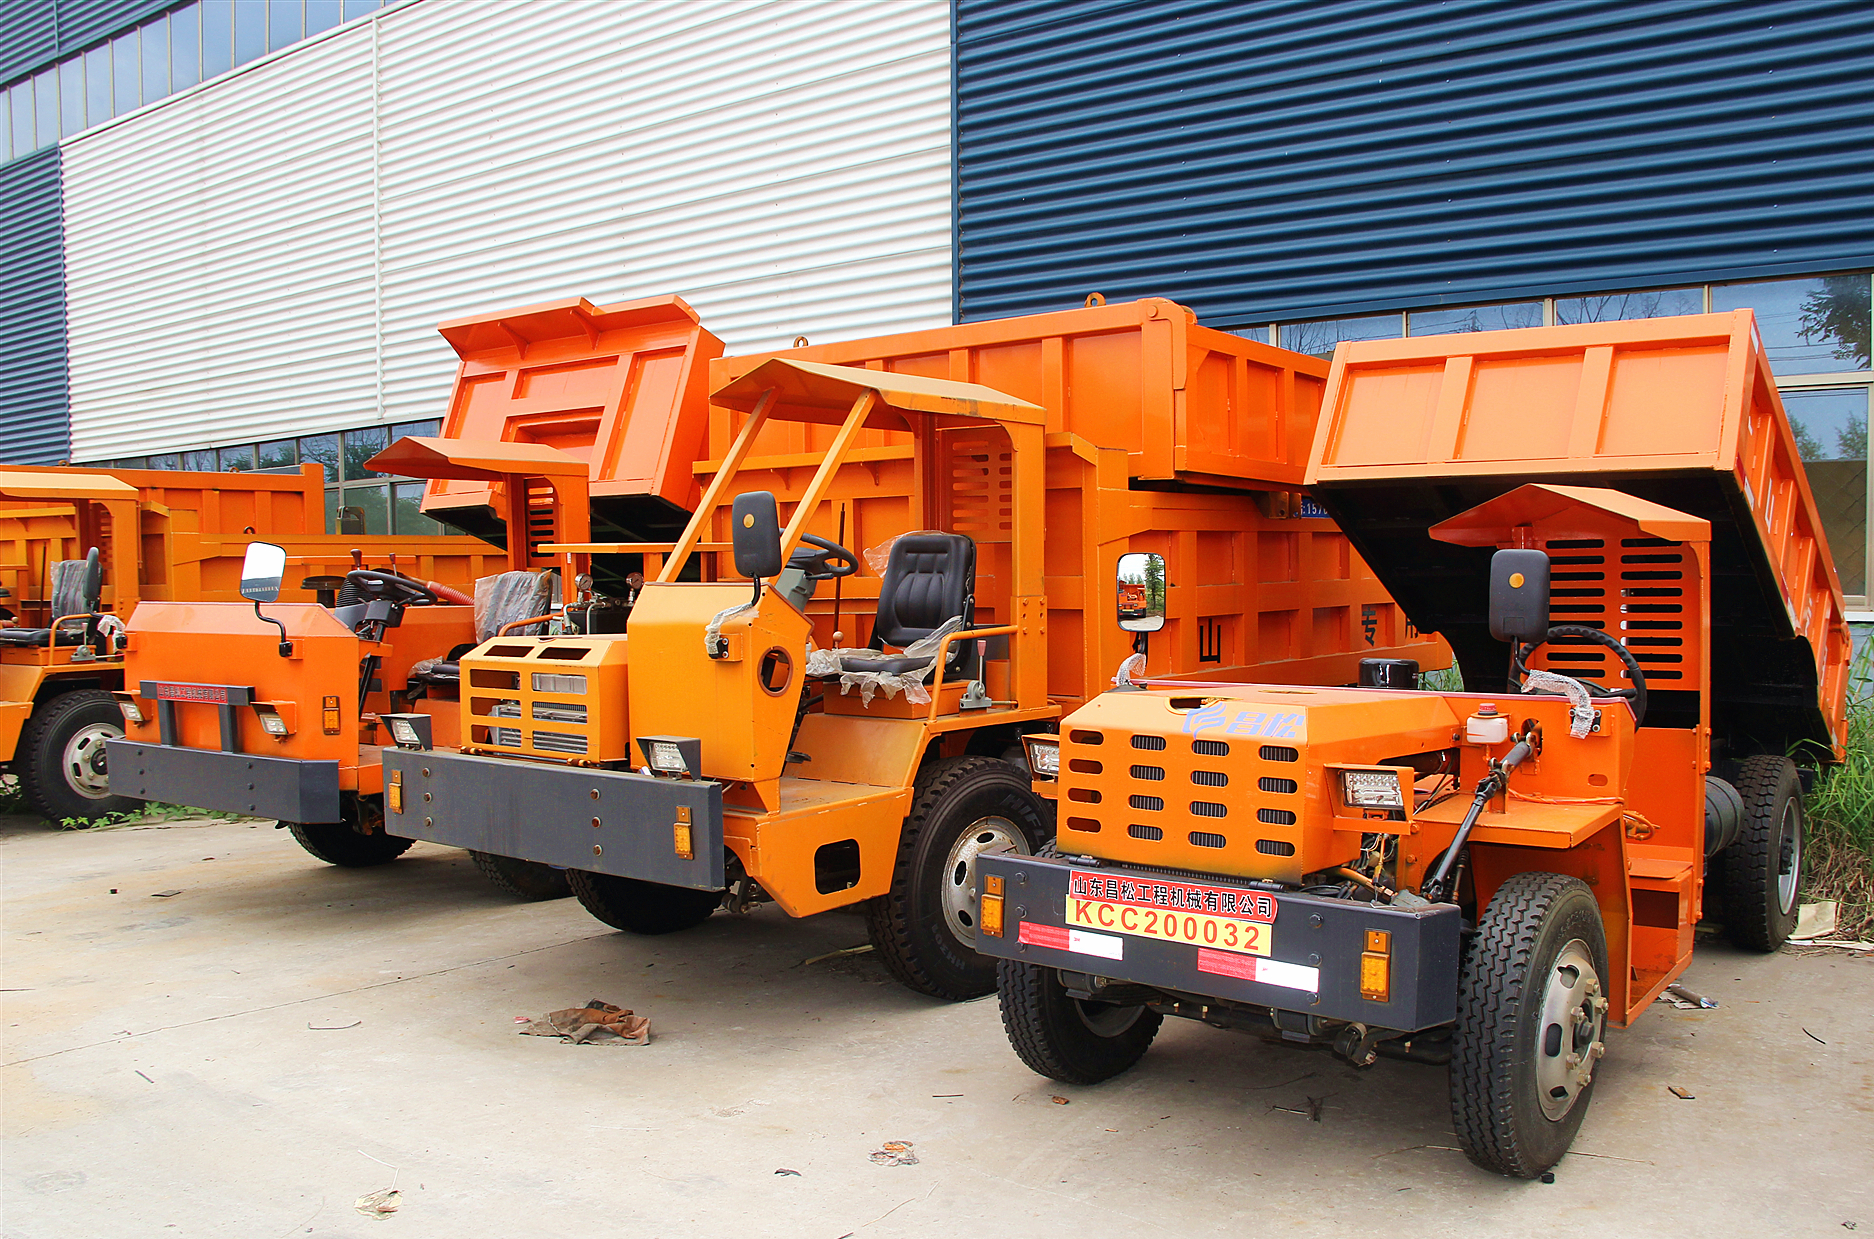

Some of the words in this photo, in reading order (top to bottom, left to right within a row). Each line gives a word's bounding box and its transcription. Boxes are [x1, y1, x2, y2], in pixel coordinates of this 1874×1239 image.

[1226, 711, 1305, 738] 昌松
[1073, 876, 1273, 918] 山东昌松工程机械有限公司
[1075, 900, 1260, 950] KCC200032
